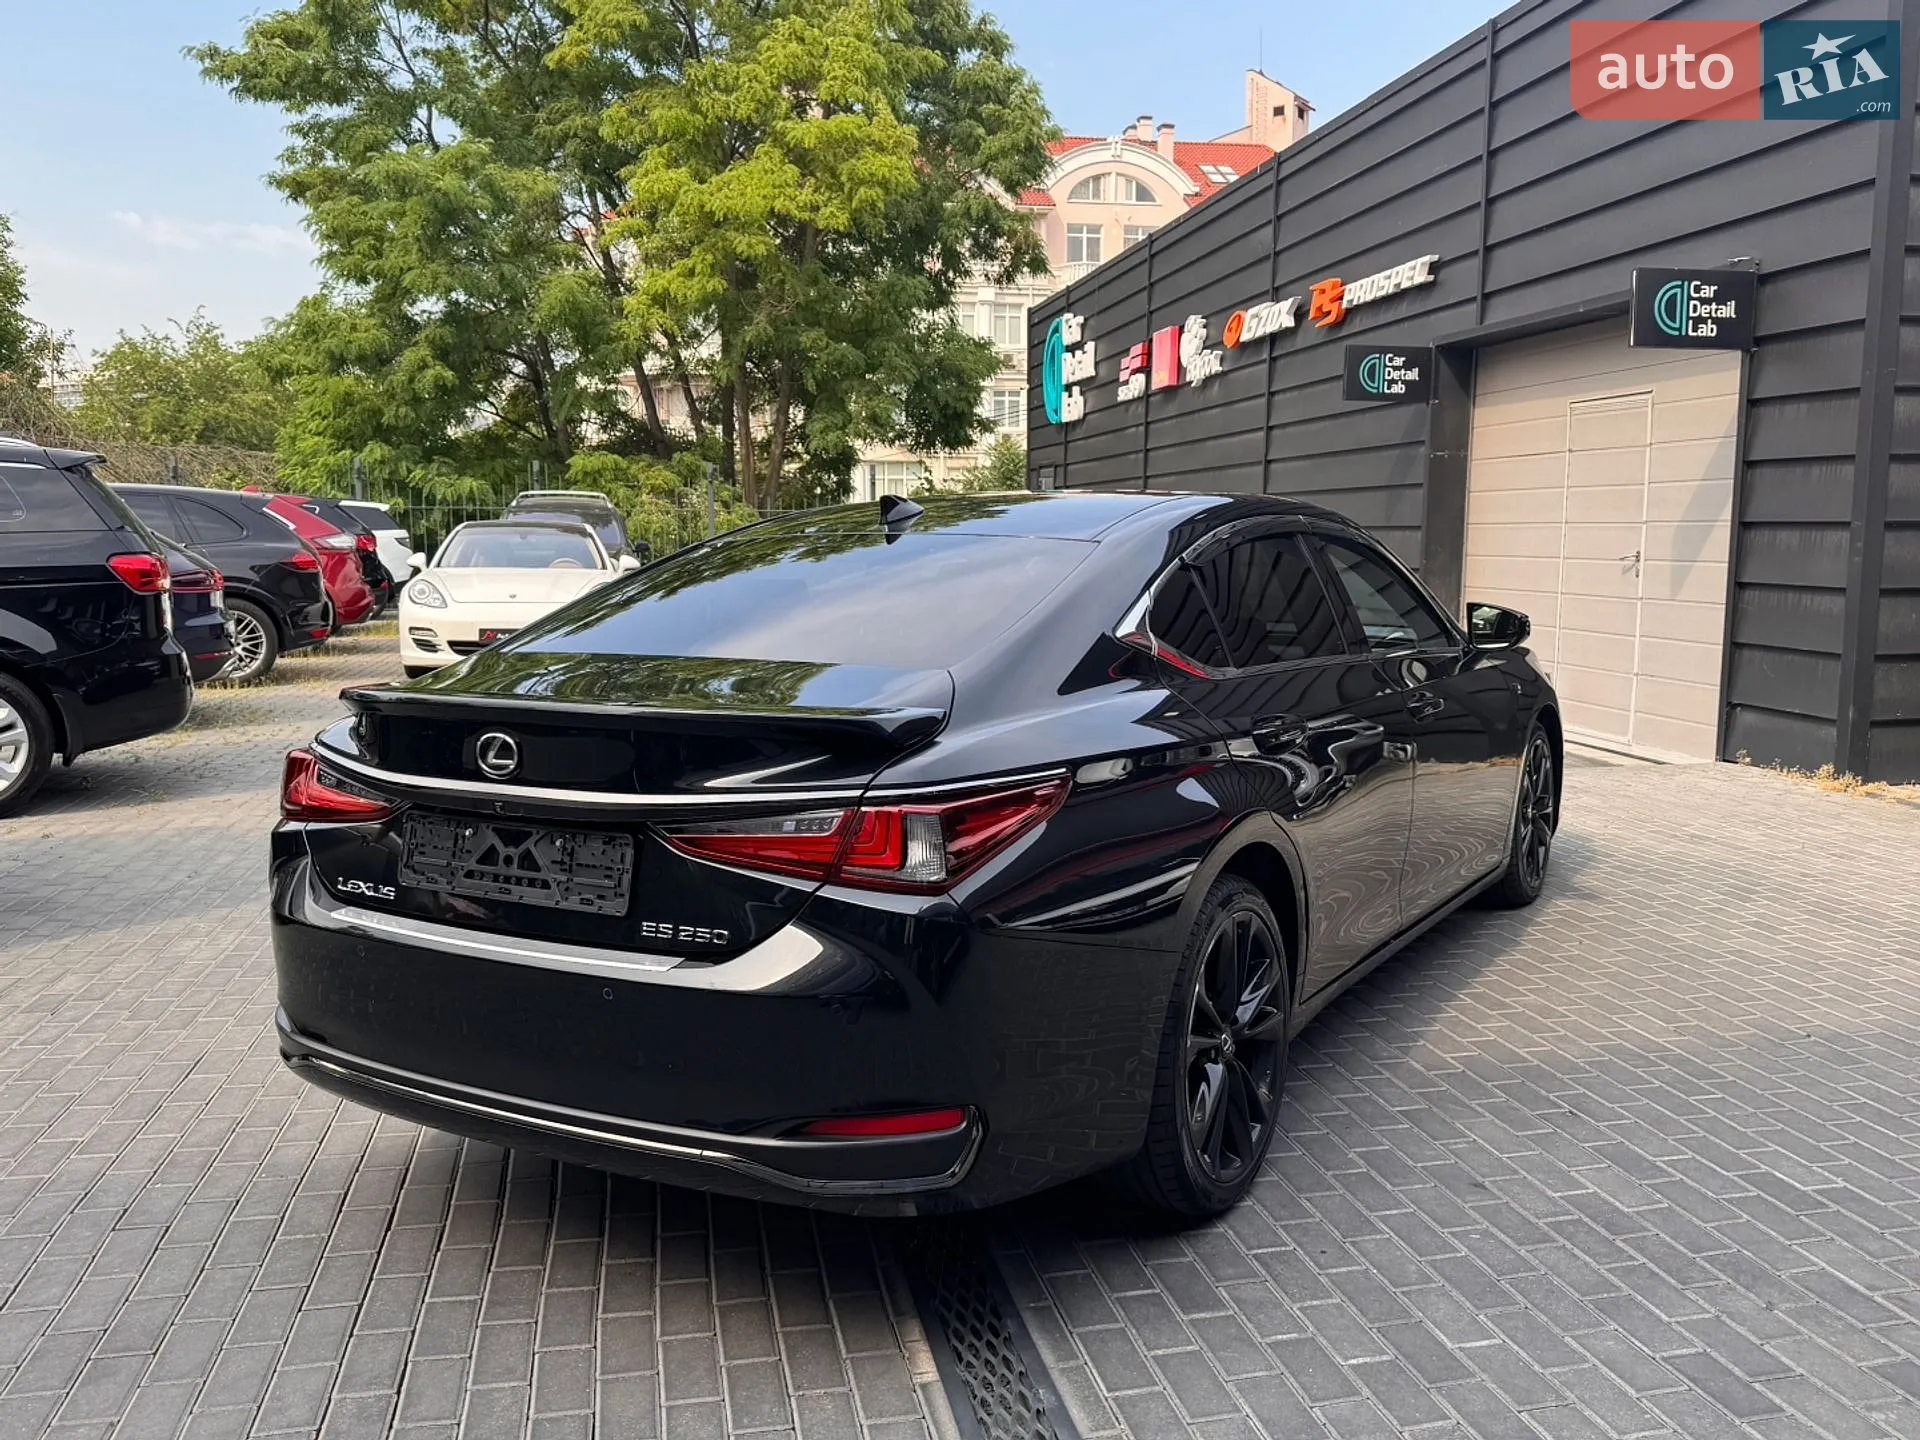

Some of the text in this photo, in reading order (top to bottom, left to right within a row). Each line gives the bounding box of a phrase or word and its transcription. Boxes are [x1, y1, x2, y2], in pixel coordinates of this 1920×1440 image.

[1342, 254, 1440, 309] PROSPEC
[1690, 281, 1717, 298] Car
[1689, 301, 1736, 318] Detail
[1688, 319, 1717, 337] Lab
[1385, 353, 1406, 366] Car
[1385, 367, 1419, 381] Detail
[1384, 380, 1406, 394] Lab
[337, 877, 396, 900] LEXUS
[641, 921, 729, 944] ES 250
